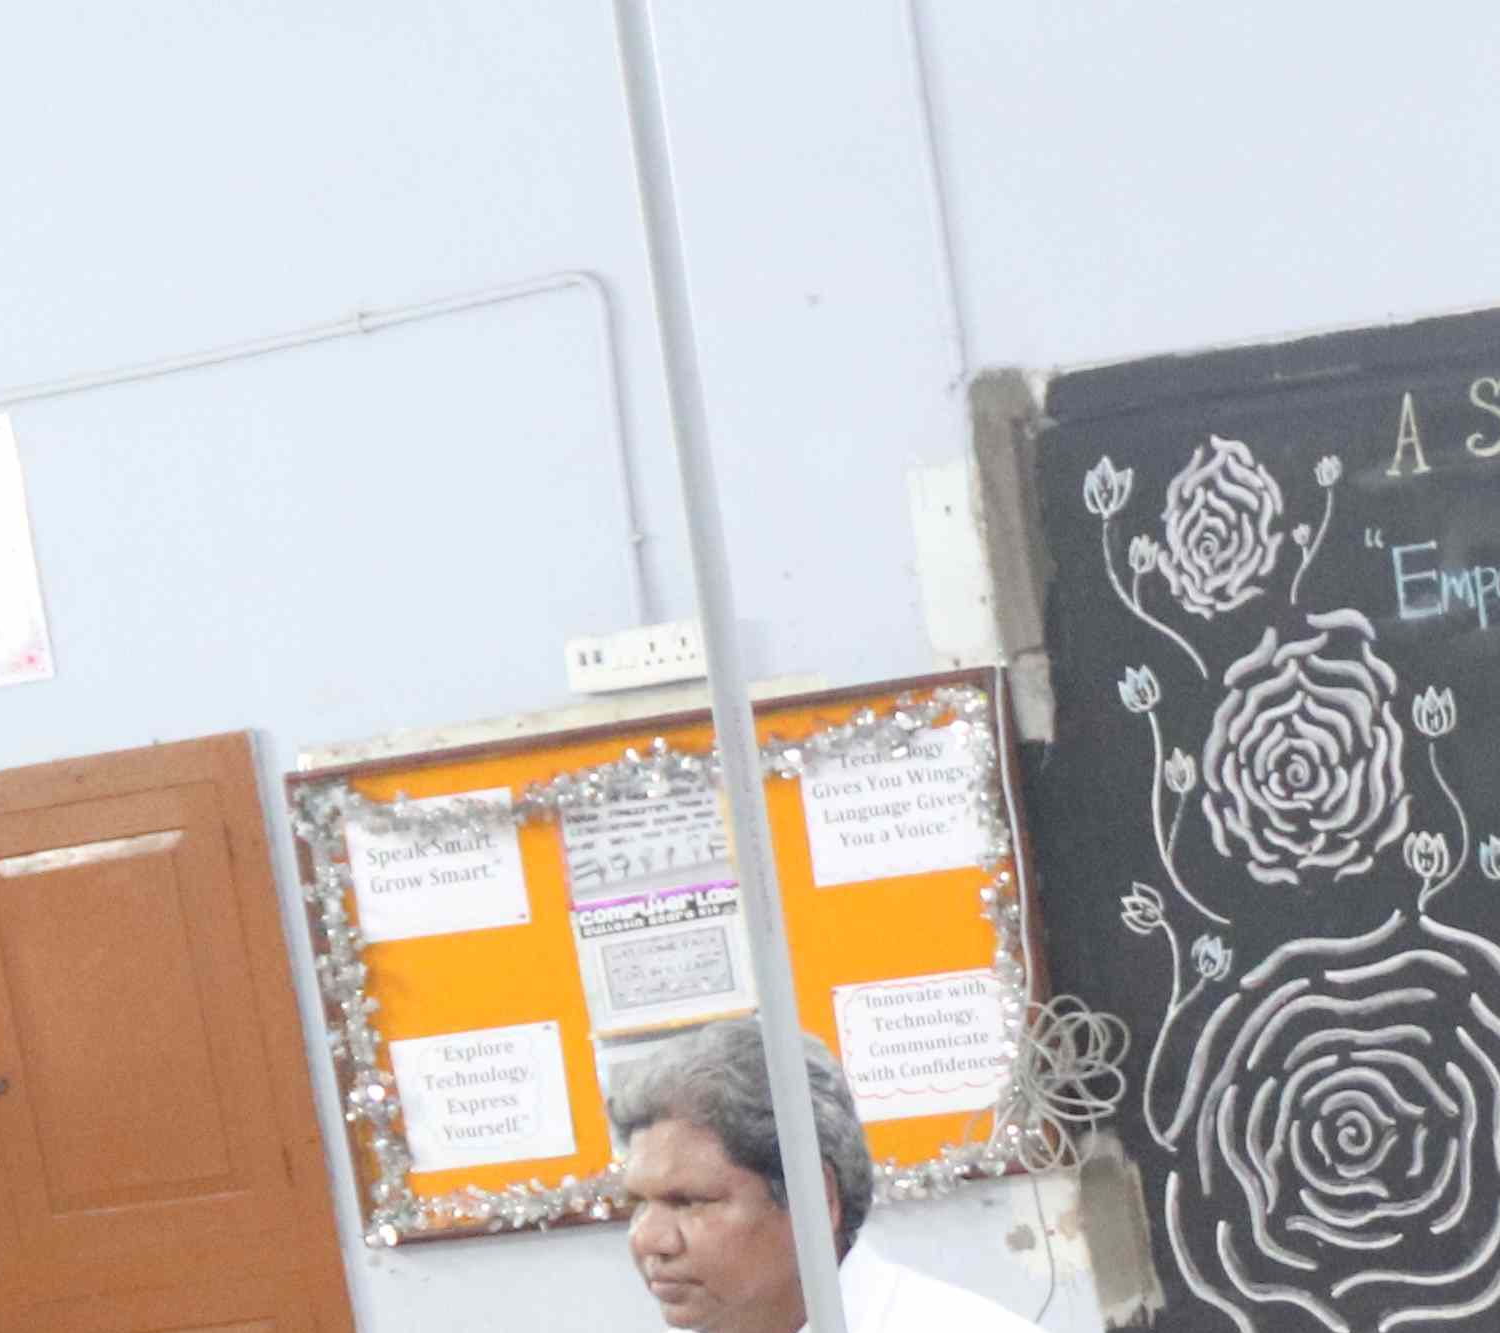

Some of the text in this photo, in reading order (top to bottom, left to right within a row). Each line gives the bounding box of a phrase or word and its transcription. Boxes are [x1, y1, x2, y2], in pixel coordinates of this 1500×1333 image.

[1386, 392, 1431, 477] A
[812, 780, 863, 800] Gives
[866, 772, 904, 791] You
[824, 791, 967, 825] Language Gives
[839, 830, 876, 849] You
[880, 829, 890, 841] a
[366, 840, 427, 869] Speak
[370, 874, 423, 895] Grow
[948, 979, 987, 998] with
[869, 1031, 989, 1058] Communicate
[858, 1065, 895, 1083] with
[446, 1093, 520, 1116] Express
